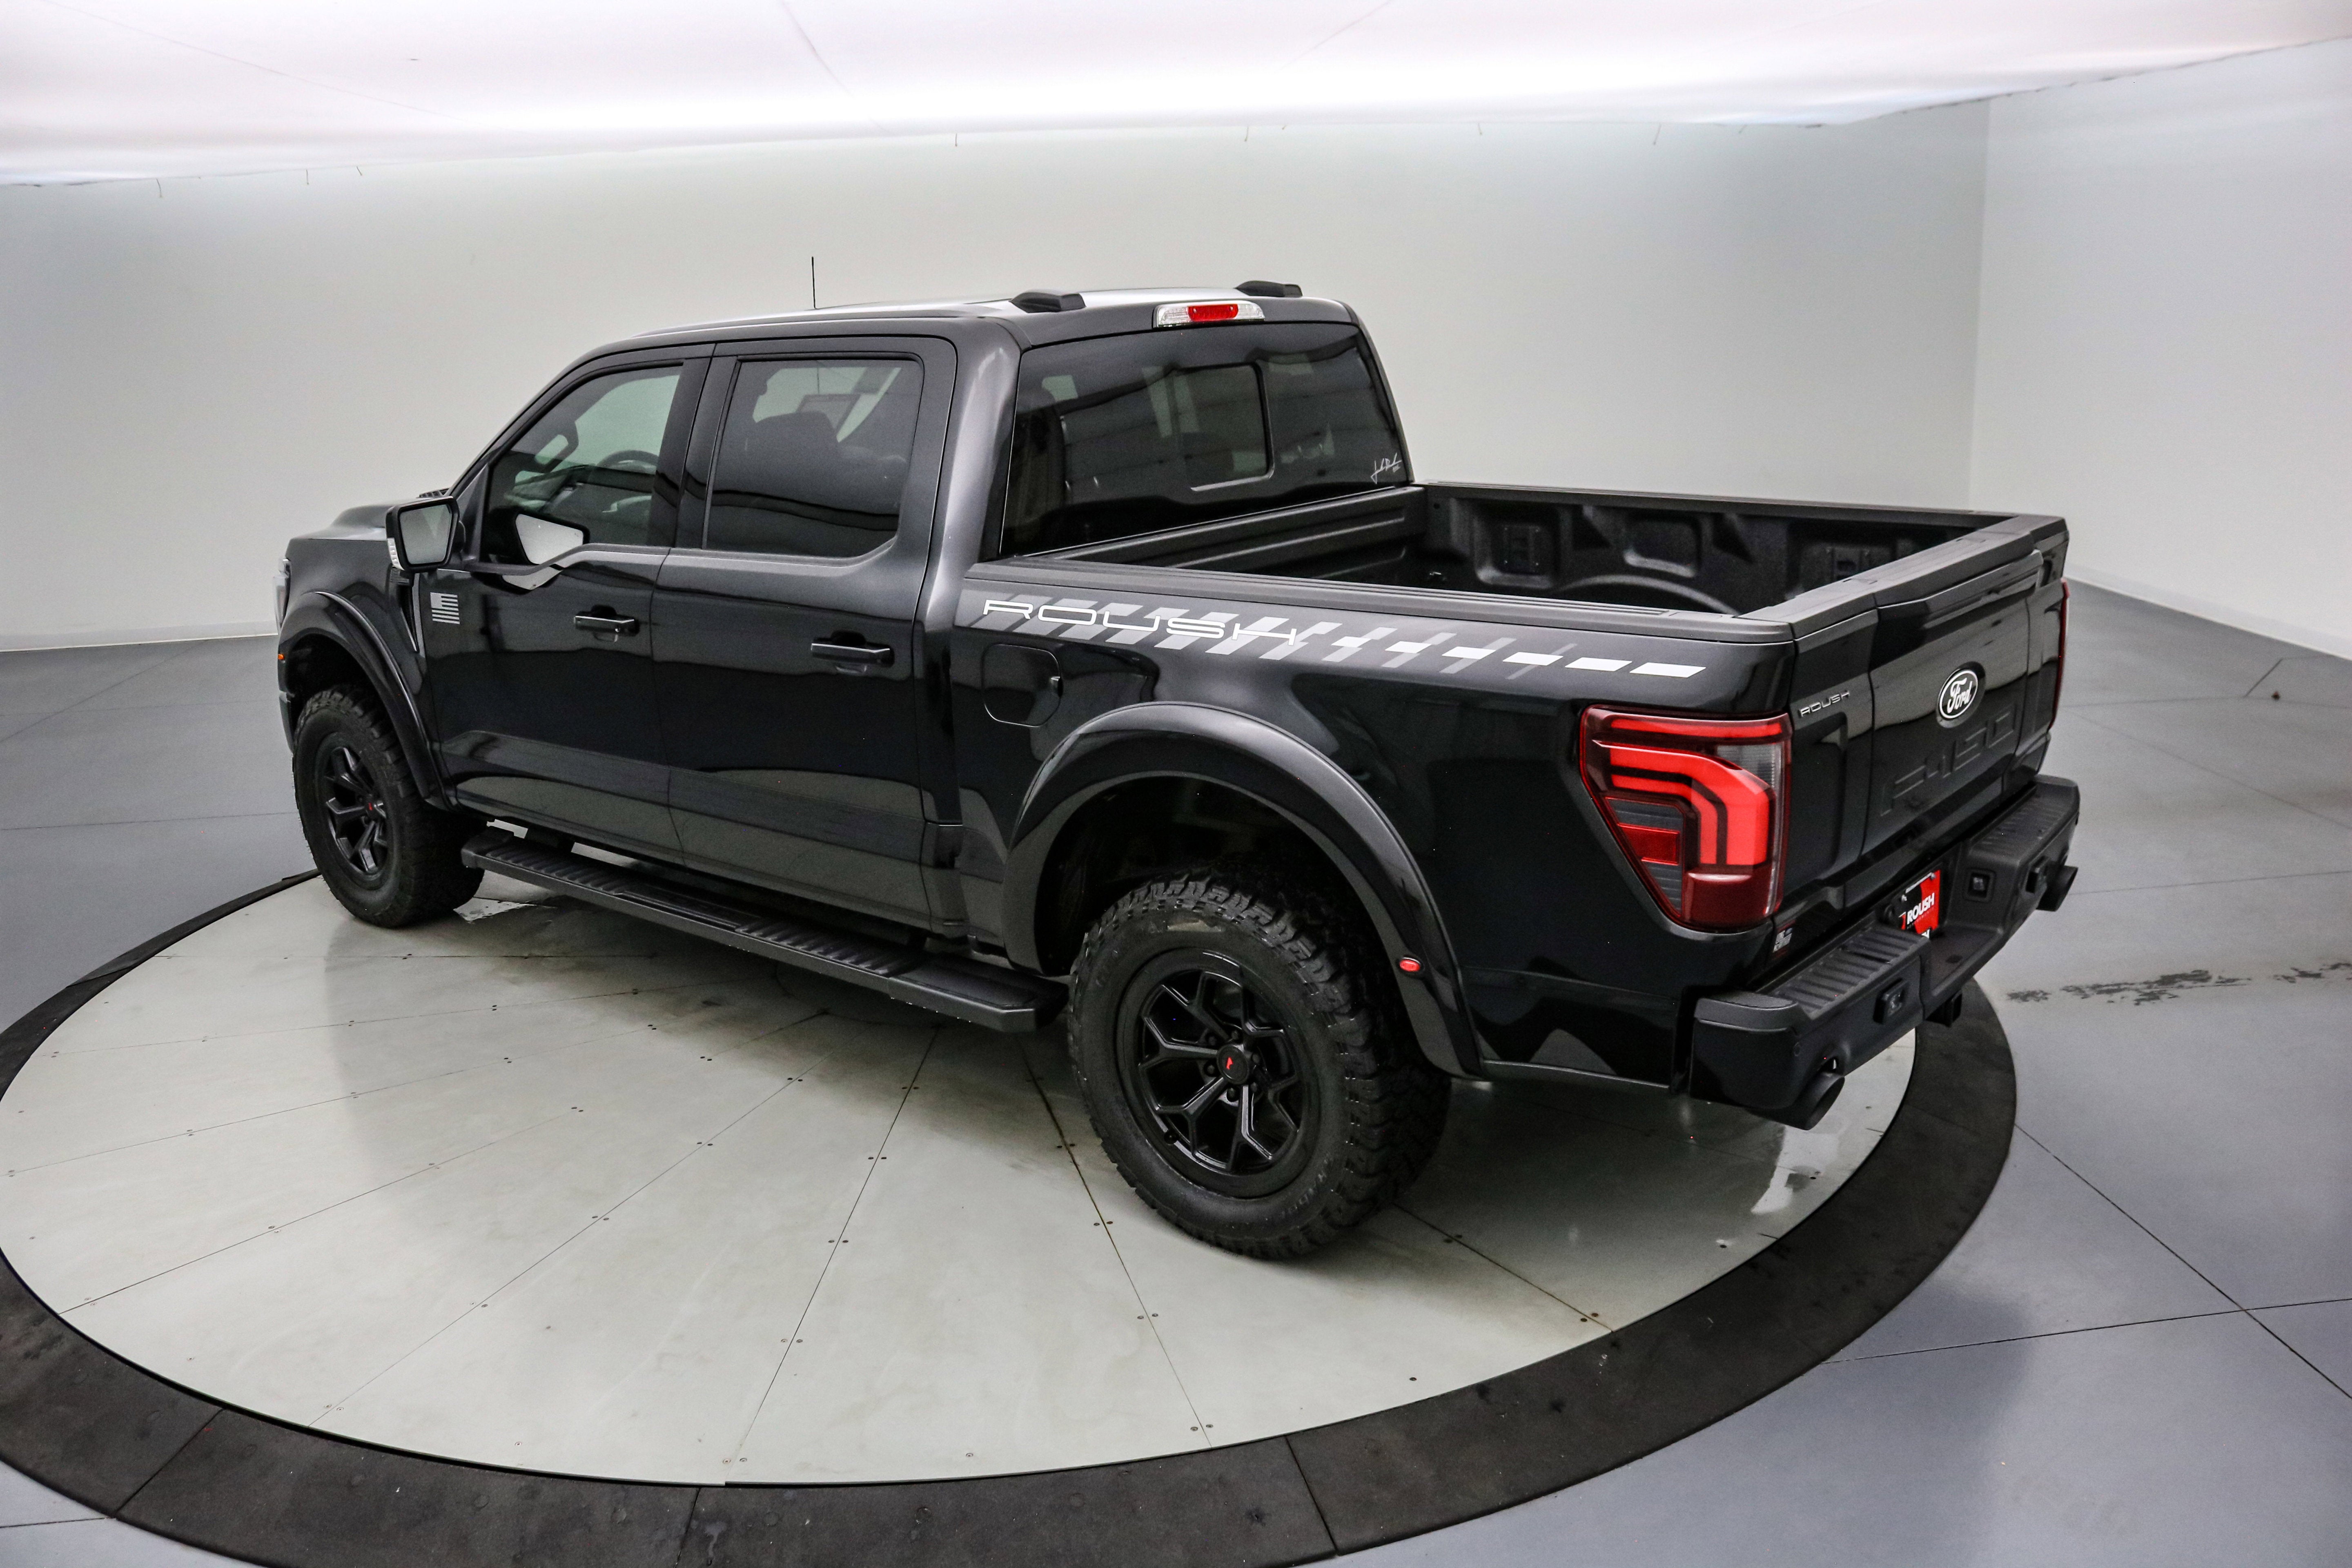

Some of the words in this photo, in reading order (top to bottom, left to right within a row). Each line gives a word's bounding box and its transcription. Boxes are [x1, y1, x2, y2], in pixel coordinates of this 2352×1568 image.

[982, 599, 1297, 646] ROUSH
[1800, 690, 1850, 717] ROUSH
[1947, 677, 1973, 714] Ford
[1907, 892, 1935, 925] ROUSH
